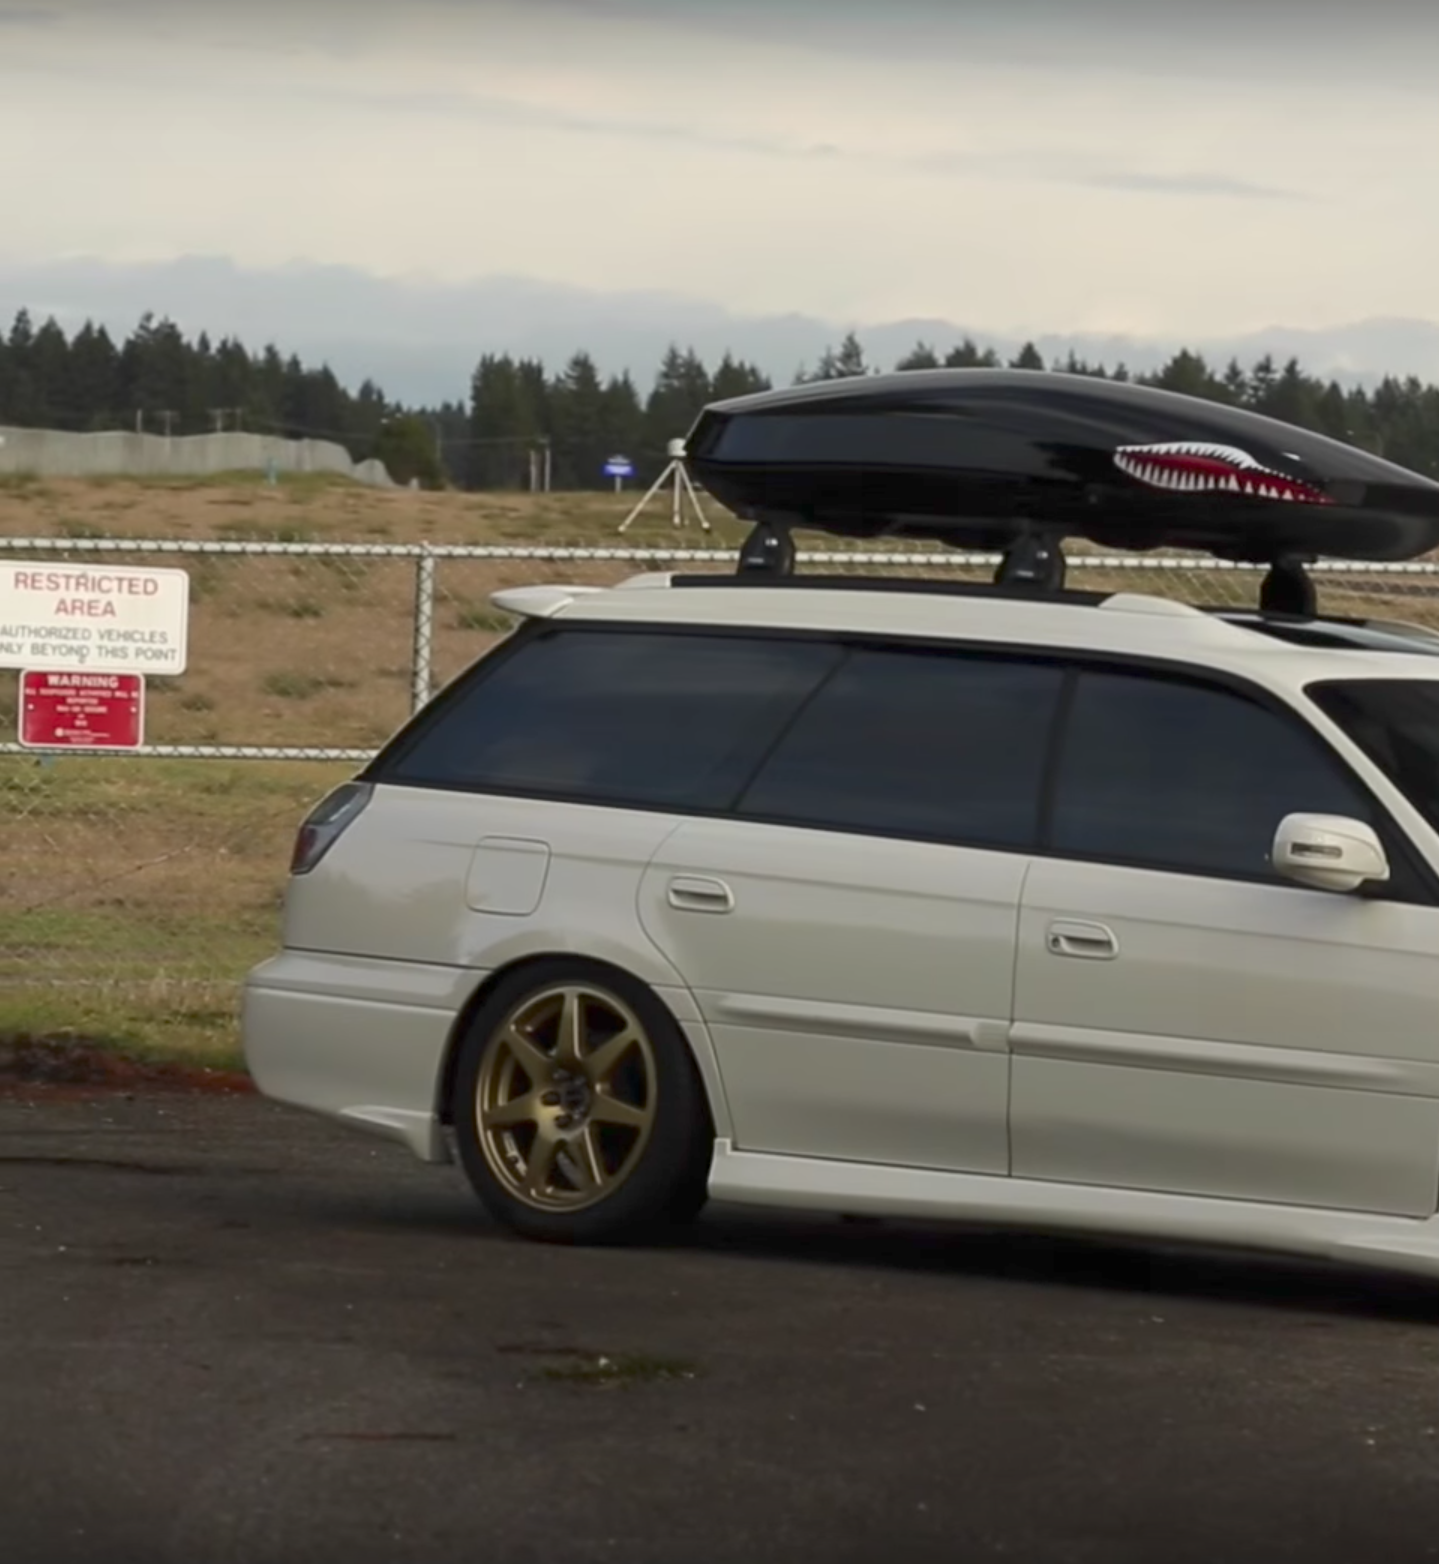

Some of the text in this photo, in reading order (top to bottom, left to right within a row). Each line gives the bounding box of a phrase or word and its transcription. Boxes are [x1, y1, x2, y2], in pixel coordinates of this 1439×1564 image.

[14, 571, 159, 596] RESTRICTED
[54, 598, 117, 618] AREA
[0, 625, 169, 644] AUTHORIZED VEHICLES
[0, 642, 177, 661] NLY BEYOND THIS POINT
[47, 674, 120, 689] WARNING
